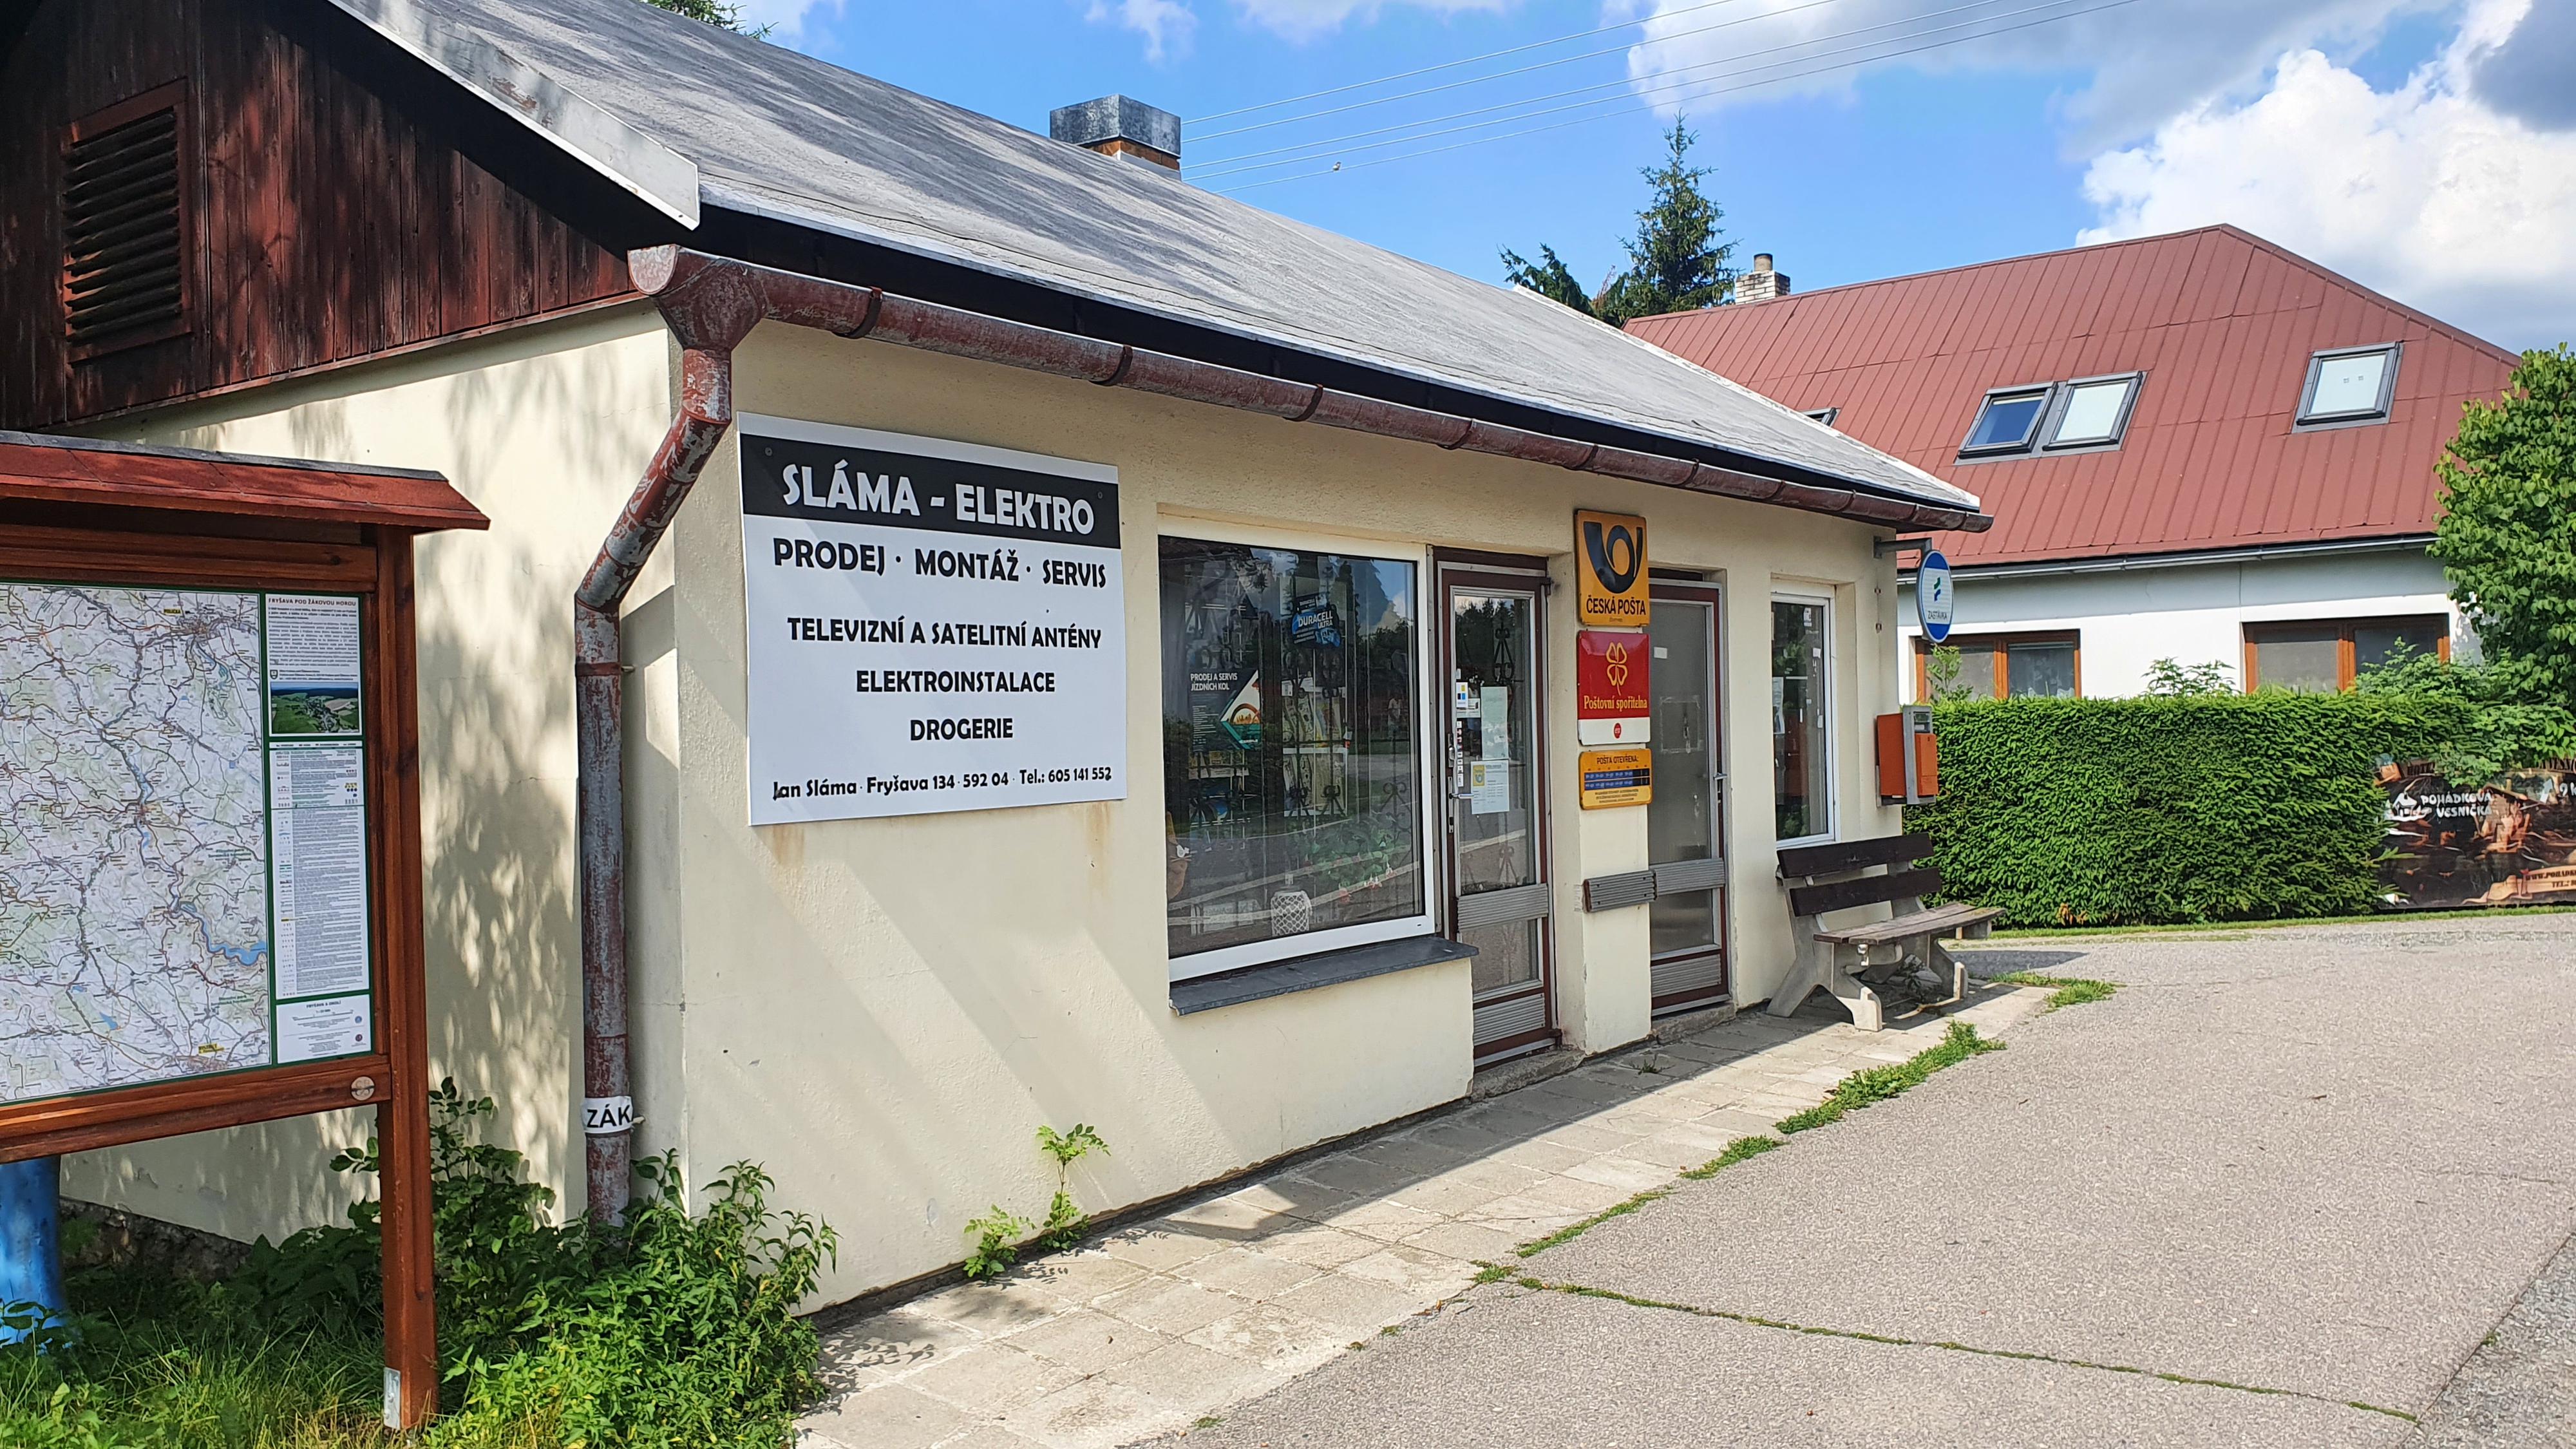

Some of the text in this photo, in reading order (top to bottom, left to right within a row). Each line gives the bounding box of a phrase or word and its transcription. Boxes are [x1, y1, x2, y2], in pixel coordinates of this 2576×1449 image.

[781, 459, 921, 516] SLÁMA
[955, 483, 1094, 535] ELEKTRO
[773, 537, 1106, 589] PRODEJ MONTÁŽ SERVIS
[1586, 594, 1646, 615] ČESKÁ POŠTA
[1298, 610, 1333, 627] DURACELL
[1318, 620, 1333, 629] ULTRA
[787, 615, 1101, 649] TELEVIZNÍ A SATELITNÍ ANTÉNY
[857, 670, 1056, 693] ELEKTROINSTALACE
[1190, 673, 1212, 681] PRODEJ
[1218, 672, 1238, 681] SERVIS
[1191, 681, 1218, 691] JÍZDNÍCH
[1584, 695, 1647, 712] Poštovní spořitelna
[910, 717, 1014, 741] DROGERIE
[1596, 755, 1613, 764] POŠTA
[773, 766, 1112, 800] Jan Sláma Fryšava 134 592 04 Tel.: 605 141 552
[2420, 790, 2492, 806] POHÁDKOVÁ
[2436, 804, 2492, 818] VESNIČKA
[587, 1103, 631, 1128] ZÁK
